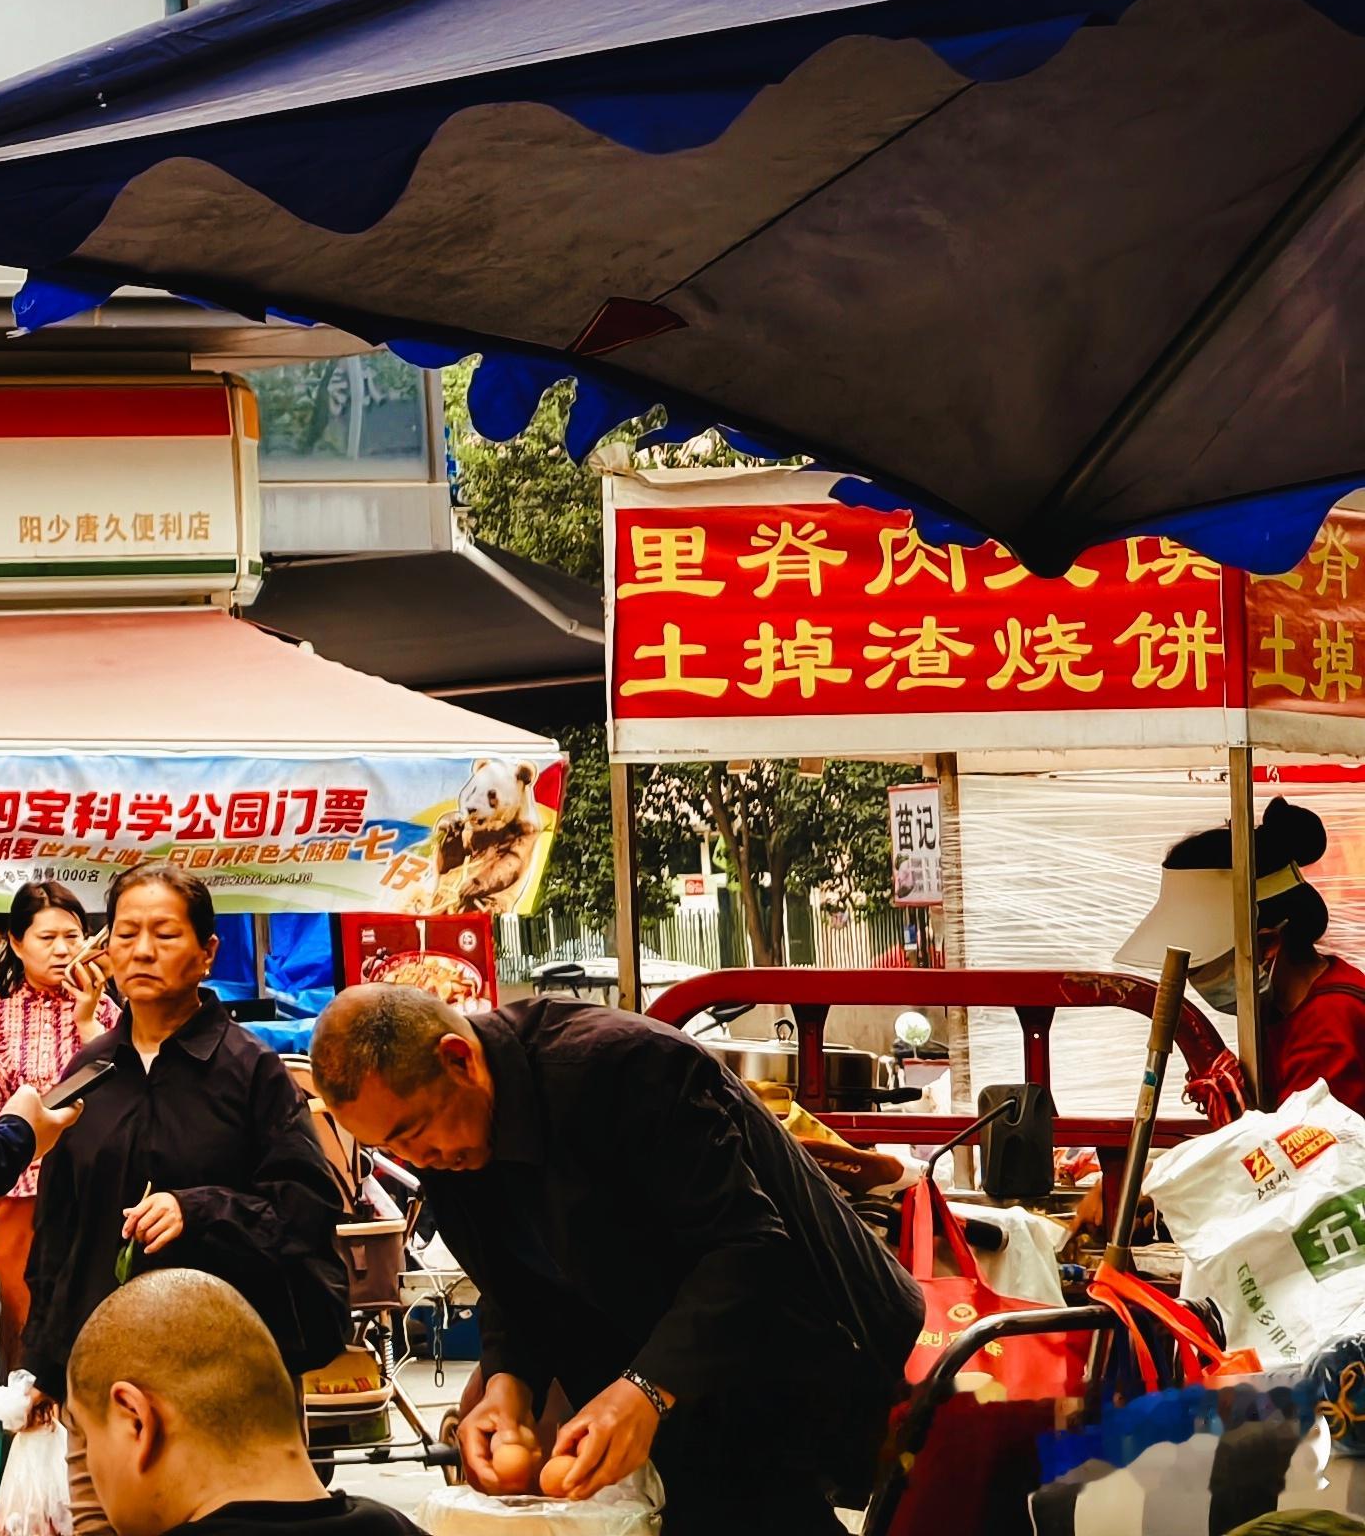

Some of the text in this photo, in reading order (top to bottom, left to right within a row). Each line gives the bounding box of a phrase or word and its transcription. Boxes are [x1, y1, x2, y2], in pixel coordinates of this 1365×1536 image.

[17, 512, 212, 544] 阳少唐久便利店
[615, 518, 1221, 599] 里脊肉馍
[1249, 522, 1360, 599] 脊
[619, 611, 1225, 700] 土掉渣烧饼
[895, 802, 937, 853] 苗记
